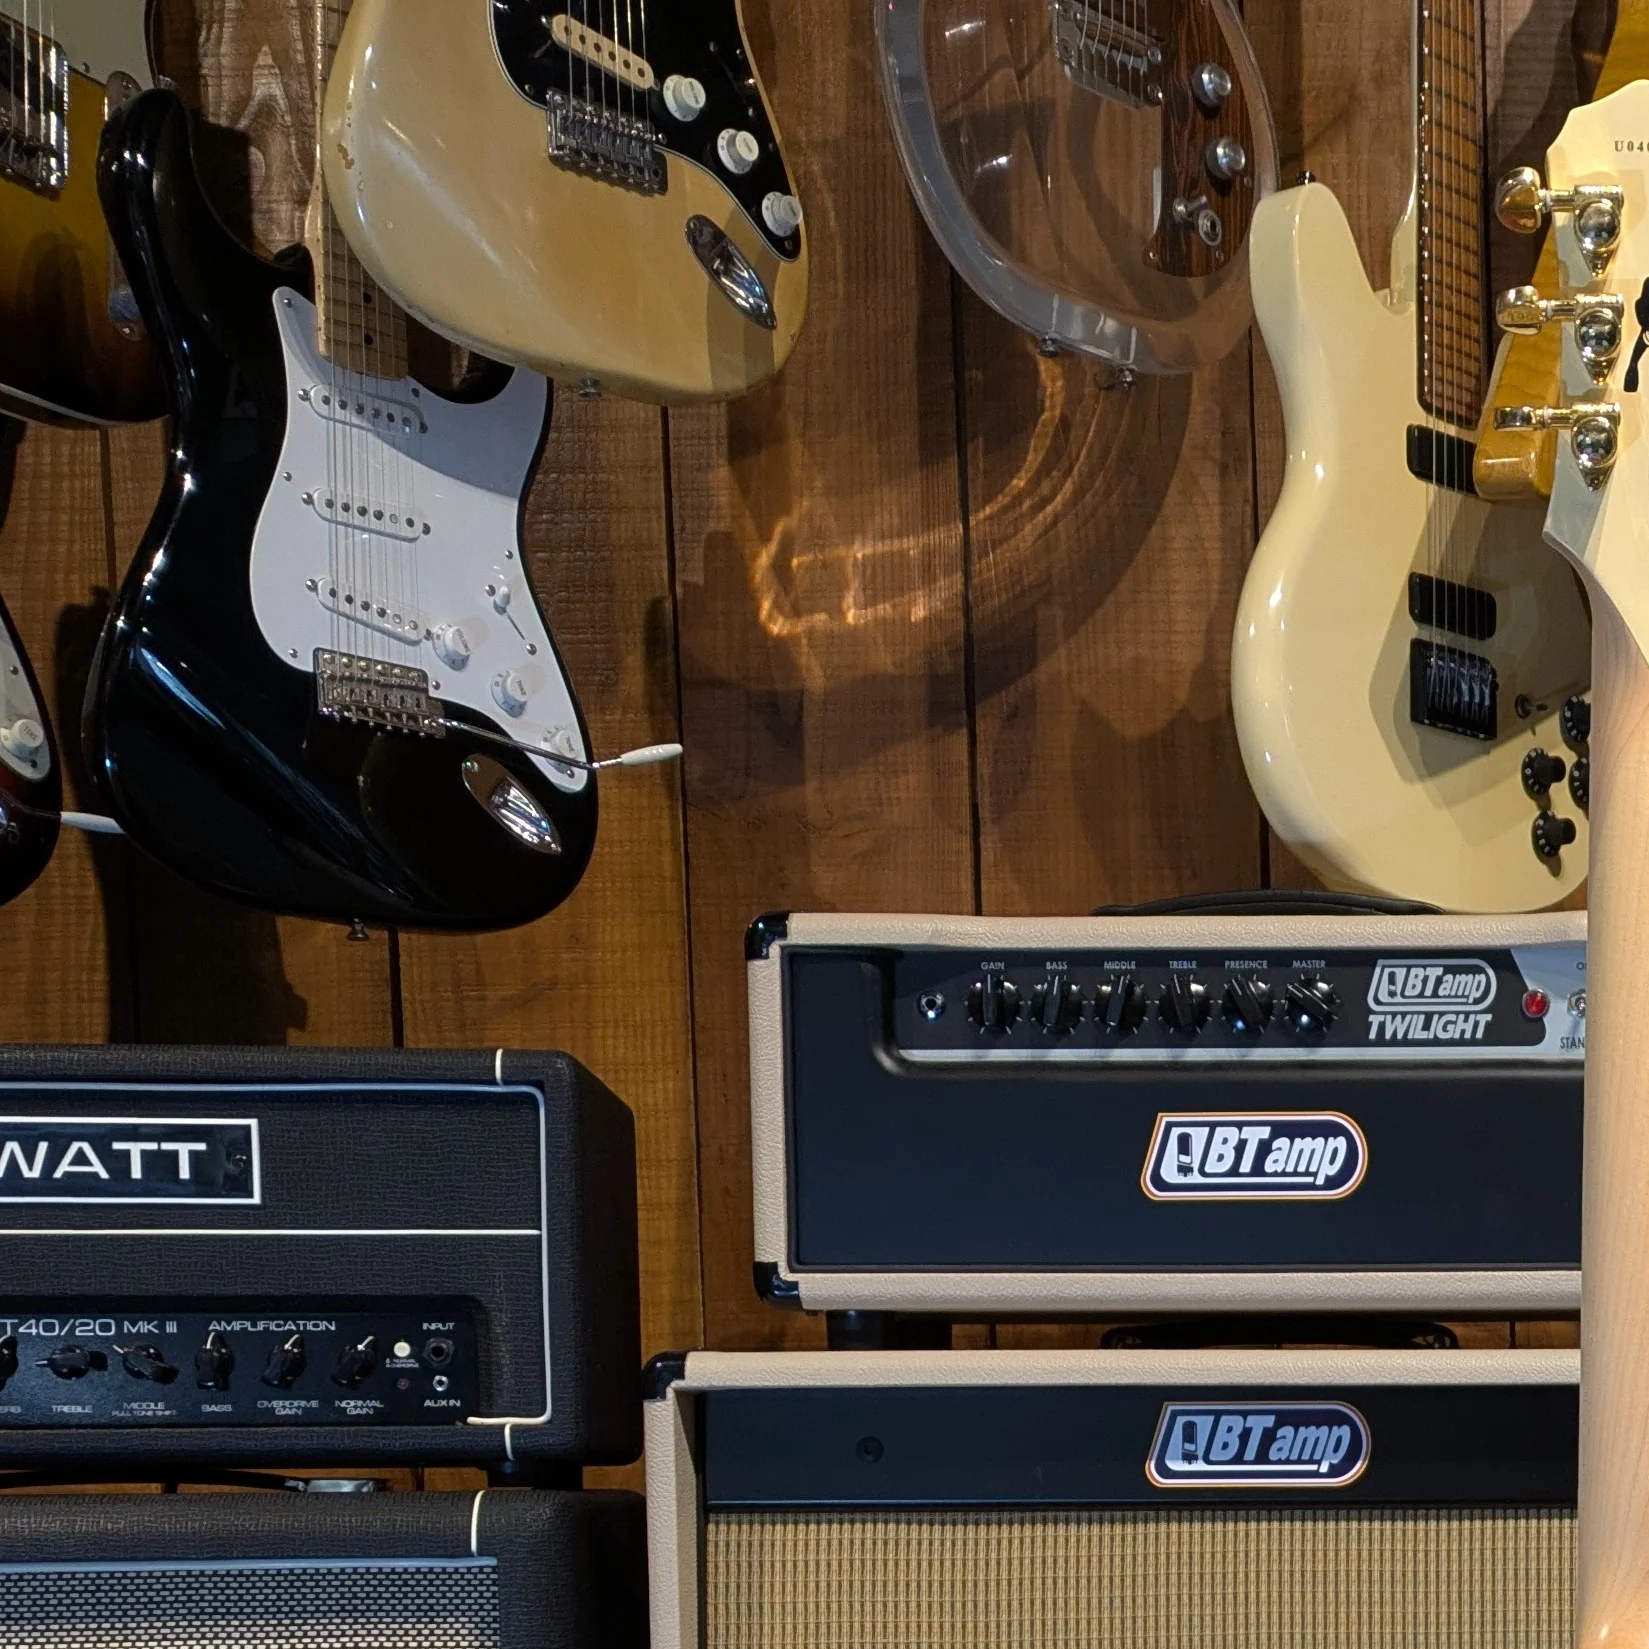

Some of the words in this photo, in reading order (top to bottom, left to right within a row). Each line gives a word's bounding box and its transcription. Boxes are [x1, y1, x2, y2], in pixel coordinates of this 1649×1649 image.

[980, 961, 1005, 970] GAIN
[1045, 961, 1068, 970] BASS
[1103, 961, 1137, 970] MIDDLE
[1168, 960, 1198, 970] TREBLE
[1224, 960, 1268, 970] PRESENCE
[1292, 959, 1326, 969] MASTER
[1404, 966, 1444, 997] BT
[1438, 973, 1487, 1004] amp
[1368, 1013, 1492, 1040] TWILIGHT
[1204, 1126, 1271, 1174] BT
[1263, 1135, 1347, 1186] amp
[123, 1320, 160, 1334] MK
[208, 1320, 337, 1332] AMPLIFICATION
[422, 1322, 456, 1330] INPUT
[201, 1404, 232, 1412] BASS
[334, 1400, 384, 1409] NORMAL
[424, 1399, 447, 1408] AUX
[275, 1407, 302, 1416] GAIN
[346, 1407, 374, 1416] GAIN
[1208, 1414, 1276, 1462] BT
[1268, 1423, 1351, 1473] amp
